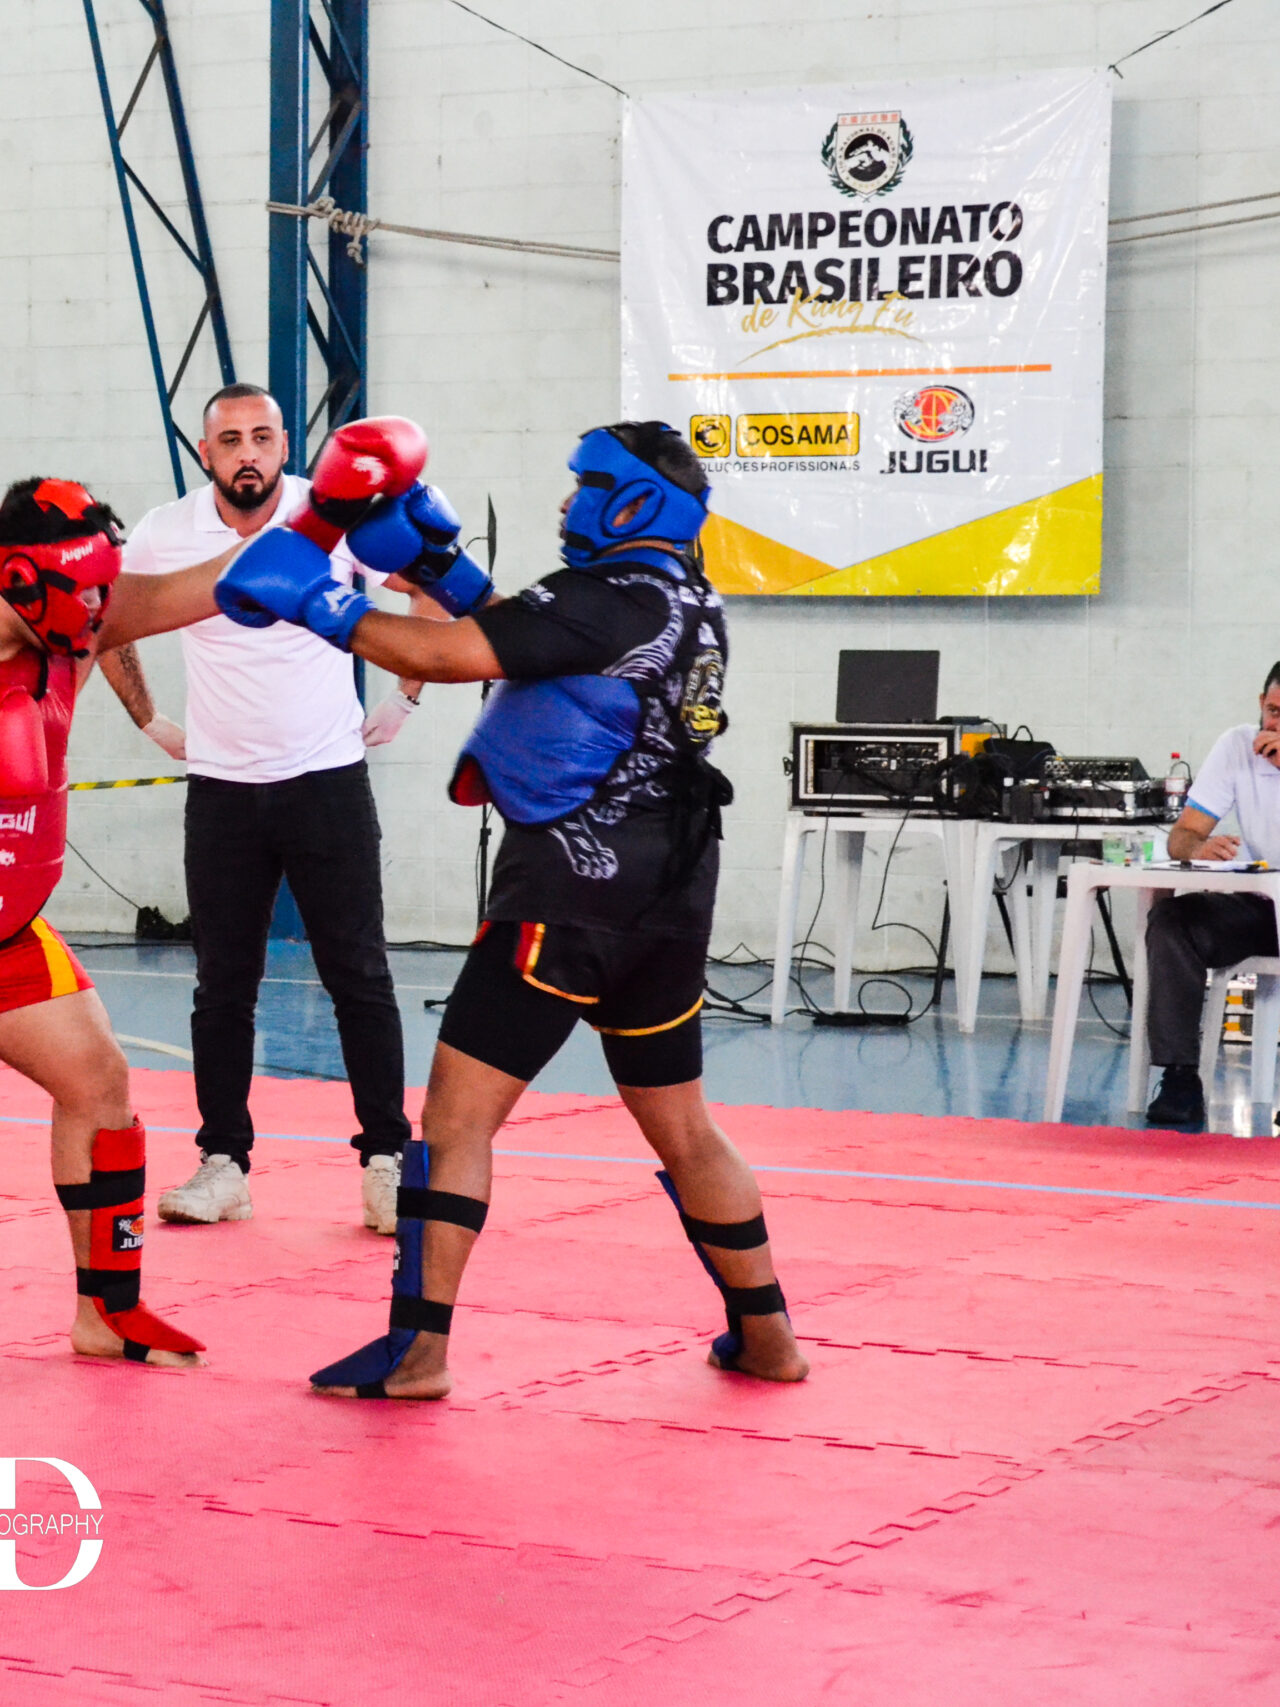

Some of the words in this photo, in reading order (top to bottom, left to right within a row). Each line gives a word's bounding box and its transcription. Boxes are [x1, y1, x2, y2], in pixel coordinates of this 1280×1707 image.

[707, 201, 1023, 254] CAMPEONATO
[707, 250, 1023, 306] BRASILEIRO
[741, 298, 779, 333] de
[787, 285, 864, 329] Kung
[872, 289, 916, 327] Fu
[746, 424, 852, 446] COSAMA
[699, 460, 759, 474] OLUÇÕES
[880, 449, 988, 474] JUGUI
